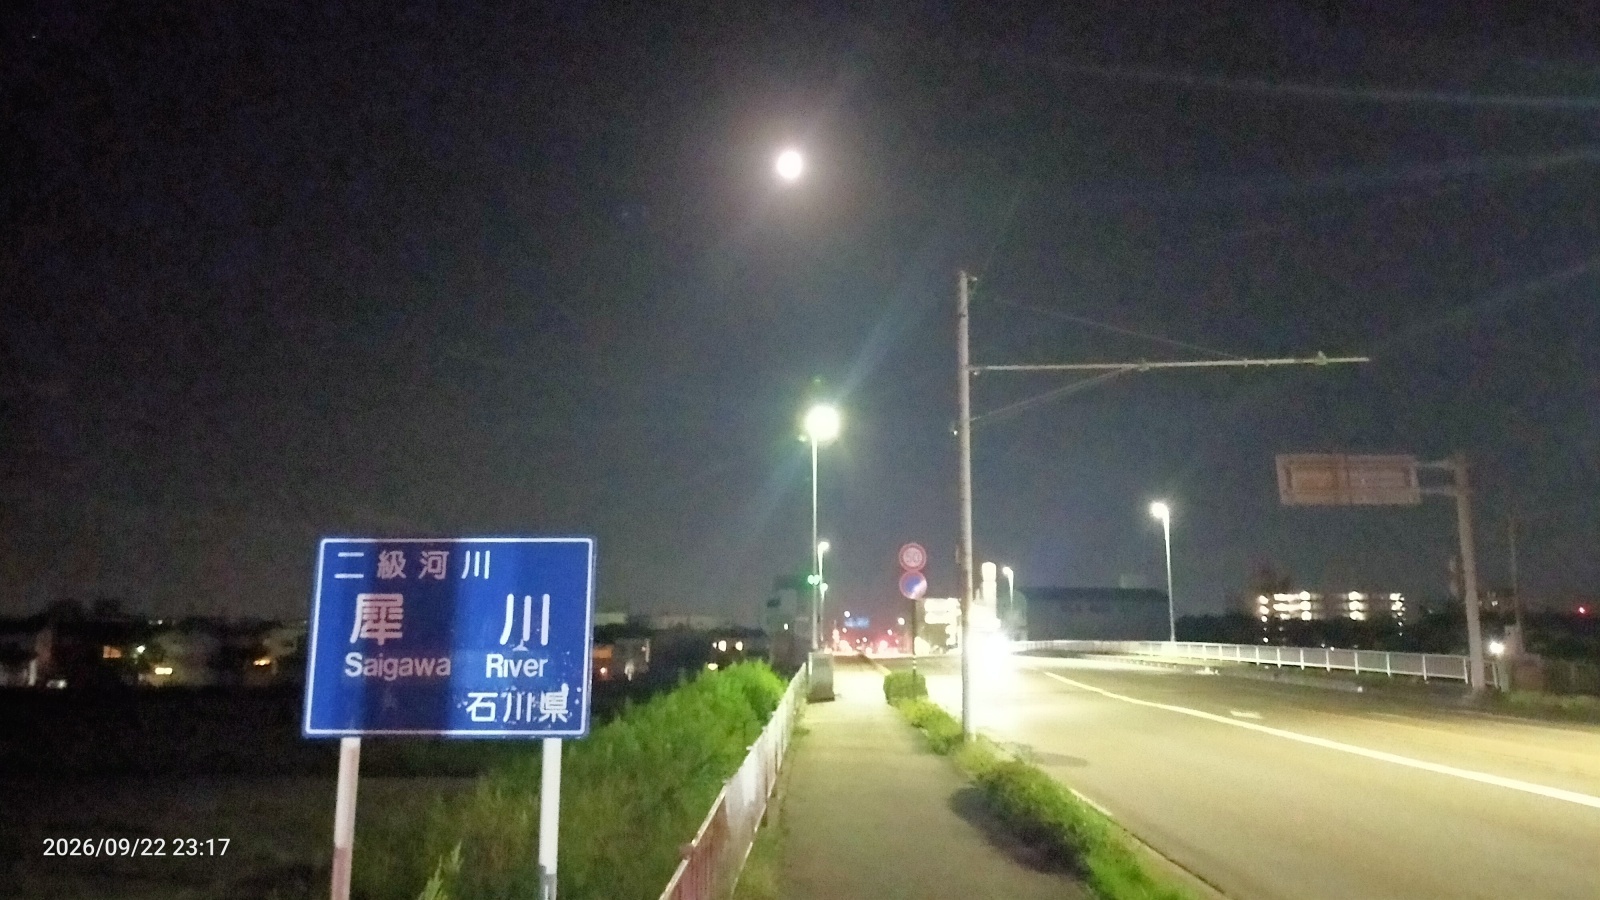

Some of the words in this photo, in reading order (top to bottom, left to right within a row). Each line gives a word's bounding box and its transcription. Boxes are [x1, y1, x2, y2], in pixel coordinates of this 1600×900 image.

[334, 550, 491, 580] 二級河川
[345, 652, 451, 681] Saigawa
[486, 653, 548, 678] River
[466, 690, 568, 723] 石川県
